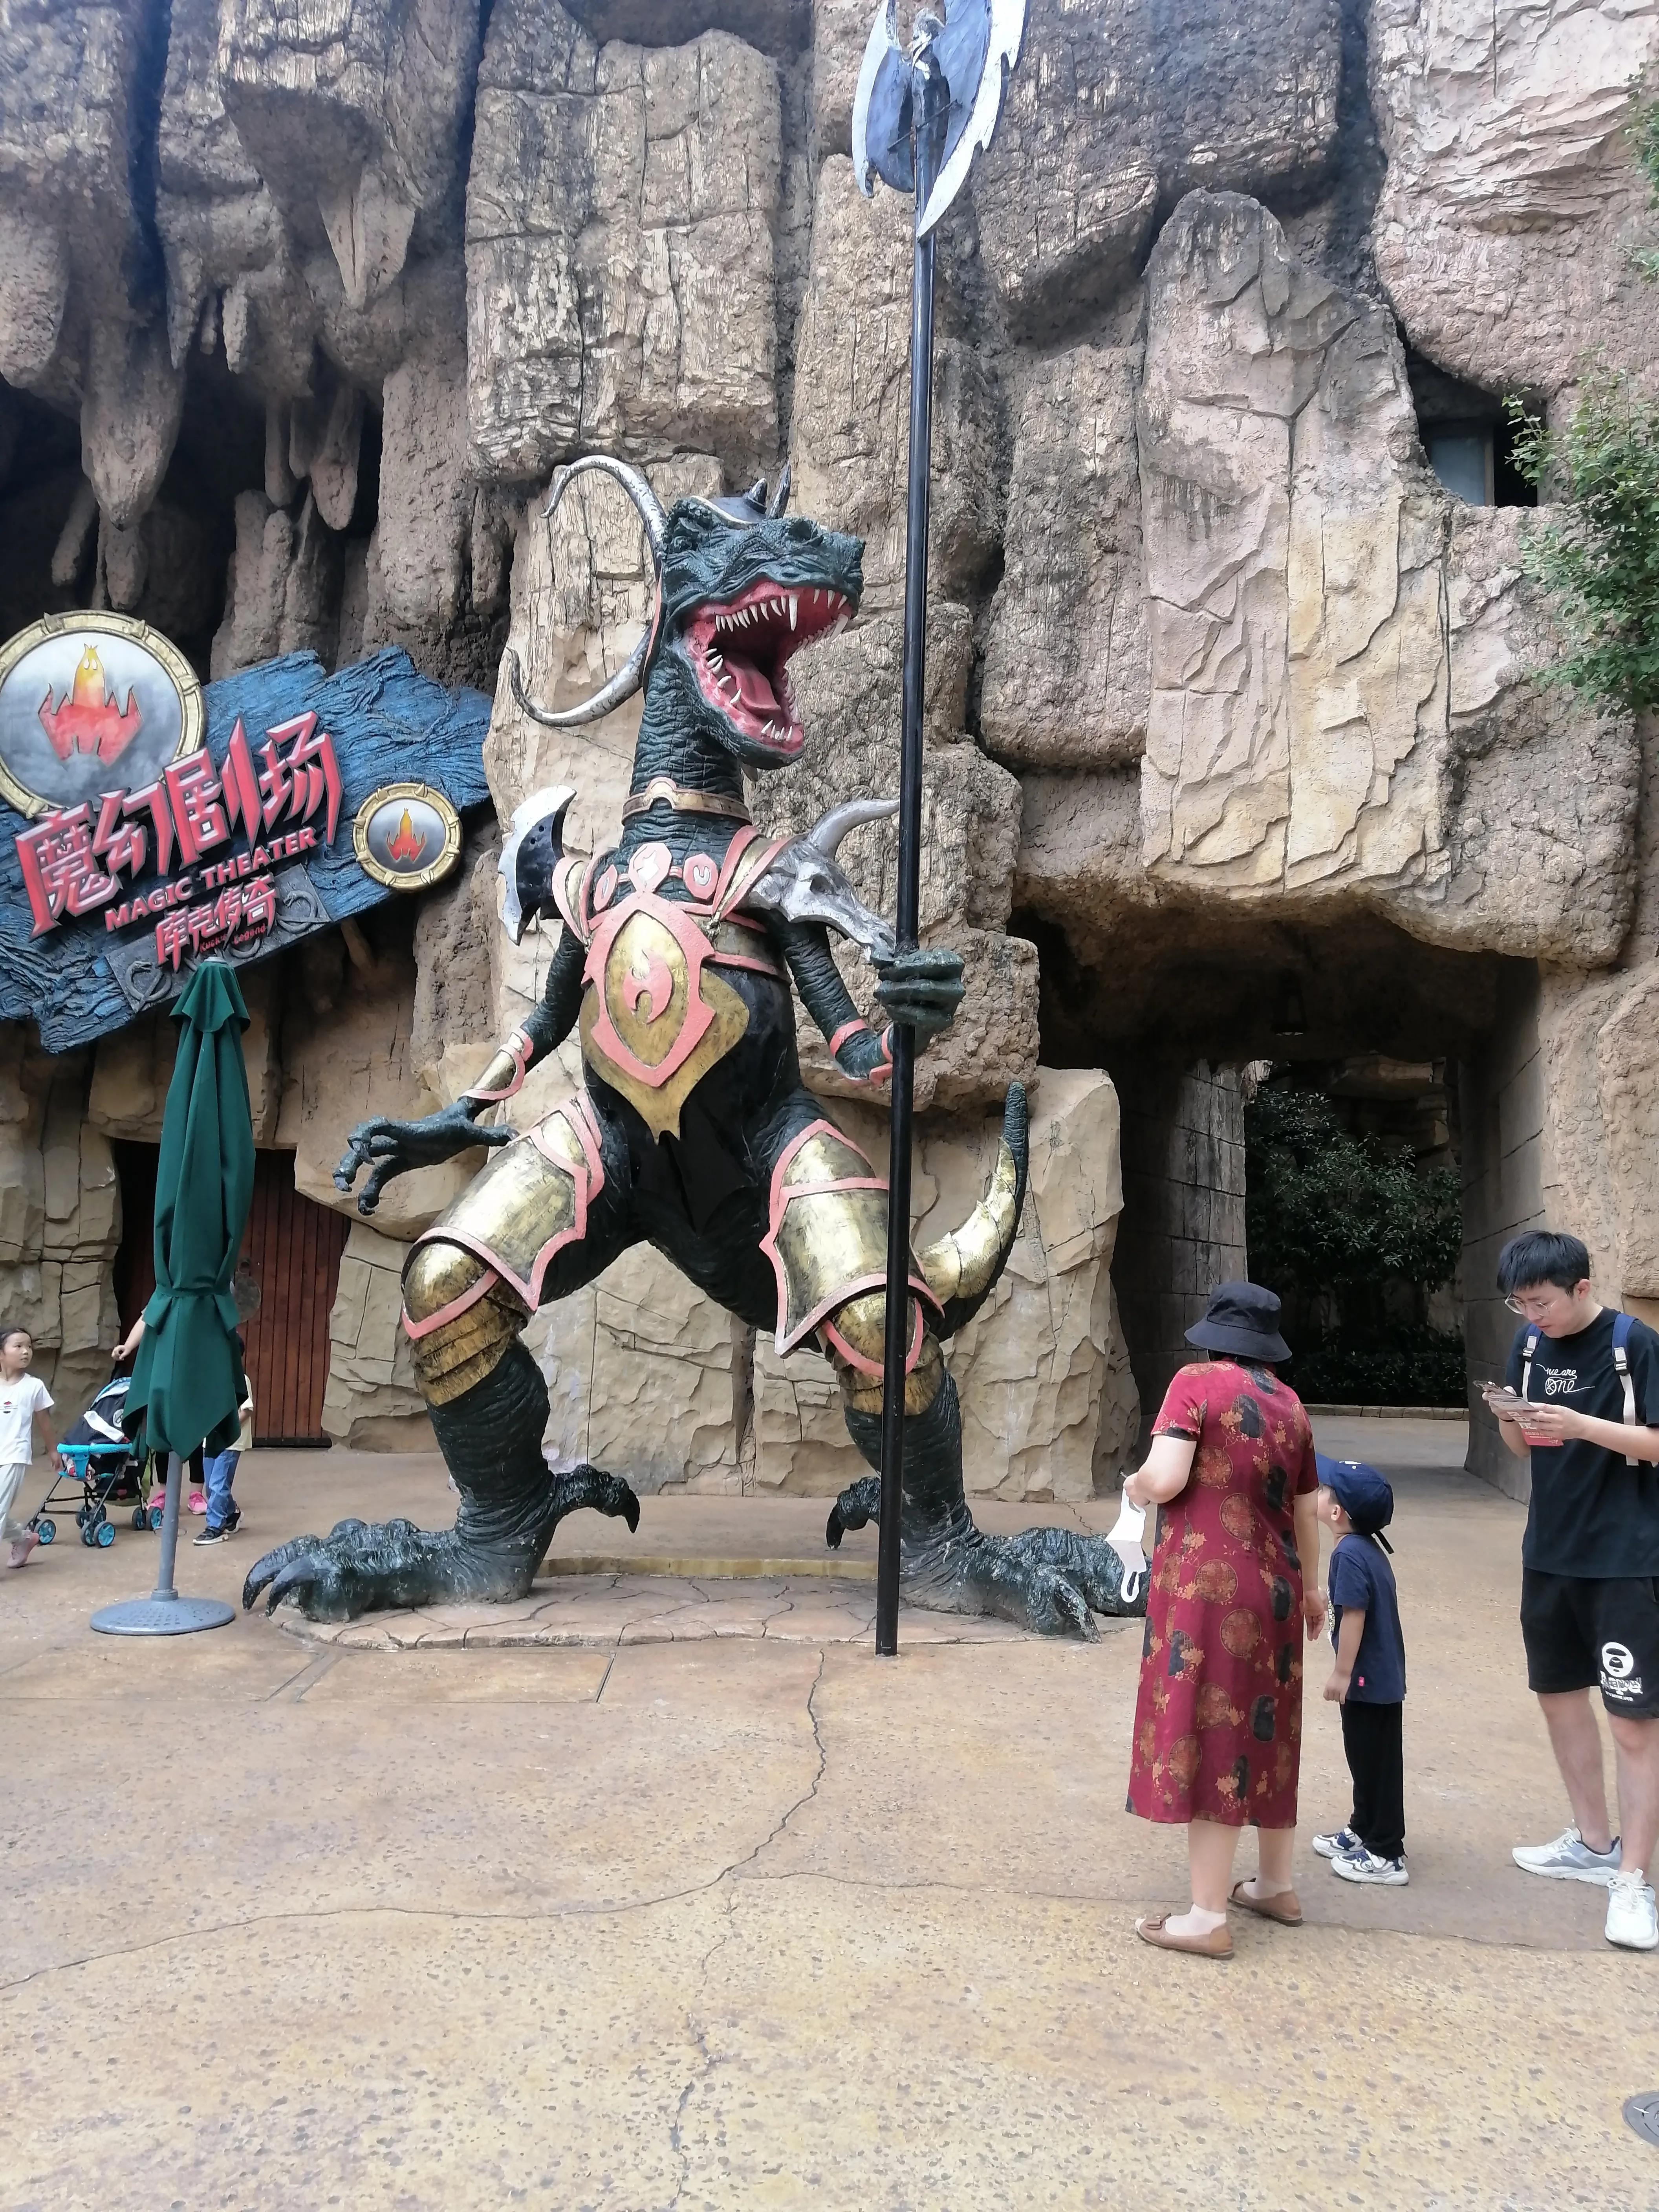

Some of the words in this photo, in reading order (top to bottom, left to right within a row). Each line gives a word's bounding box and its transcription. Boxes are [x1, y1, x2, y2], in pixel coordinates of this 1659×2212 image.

[15, 710, 343, 939] 魔幻剧场
[104, 876, 192, 932] MAGIC
[199, 826, 317, 889] THEATER
[234, 923, 266, 945] Legend
